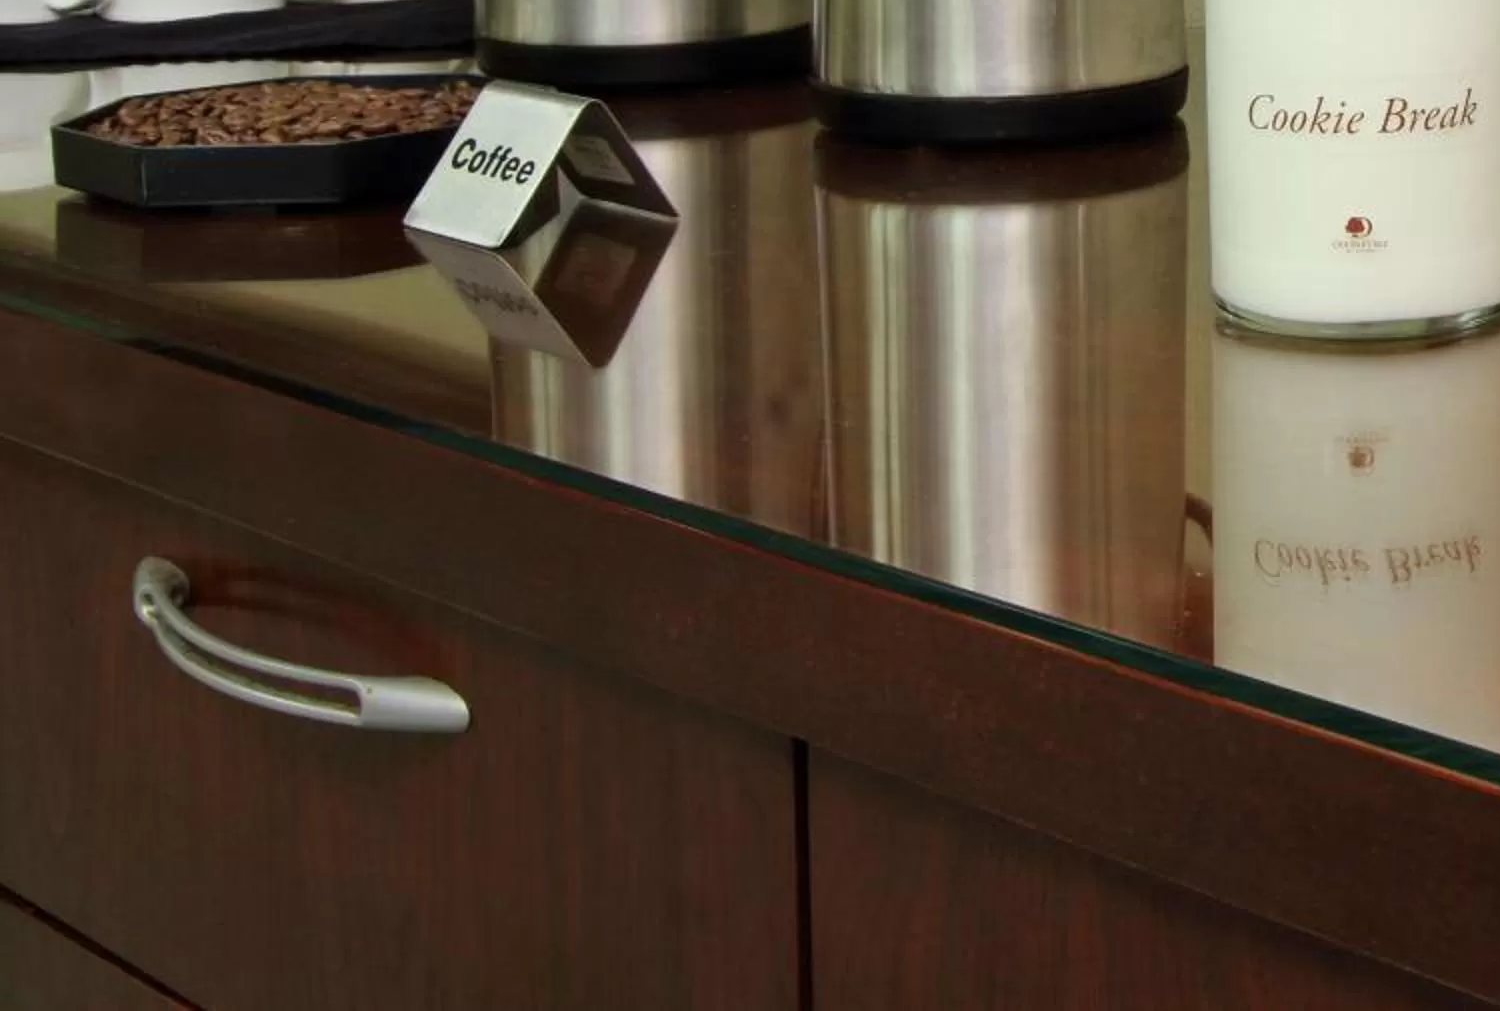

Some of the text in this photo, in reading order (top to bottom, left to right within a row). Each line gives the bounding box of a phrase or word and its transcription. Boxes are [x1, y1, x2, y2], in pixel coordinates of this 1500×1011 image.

[1248, 87, 1478, 135] Cookie Break
[450, 137, 536, 185] Coffee
